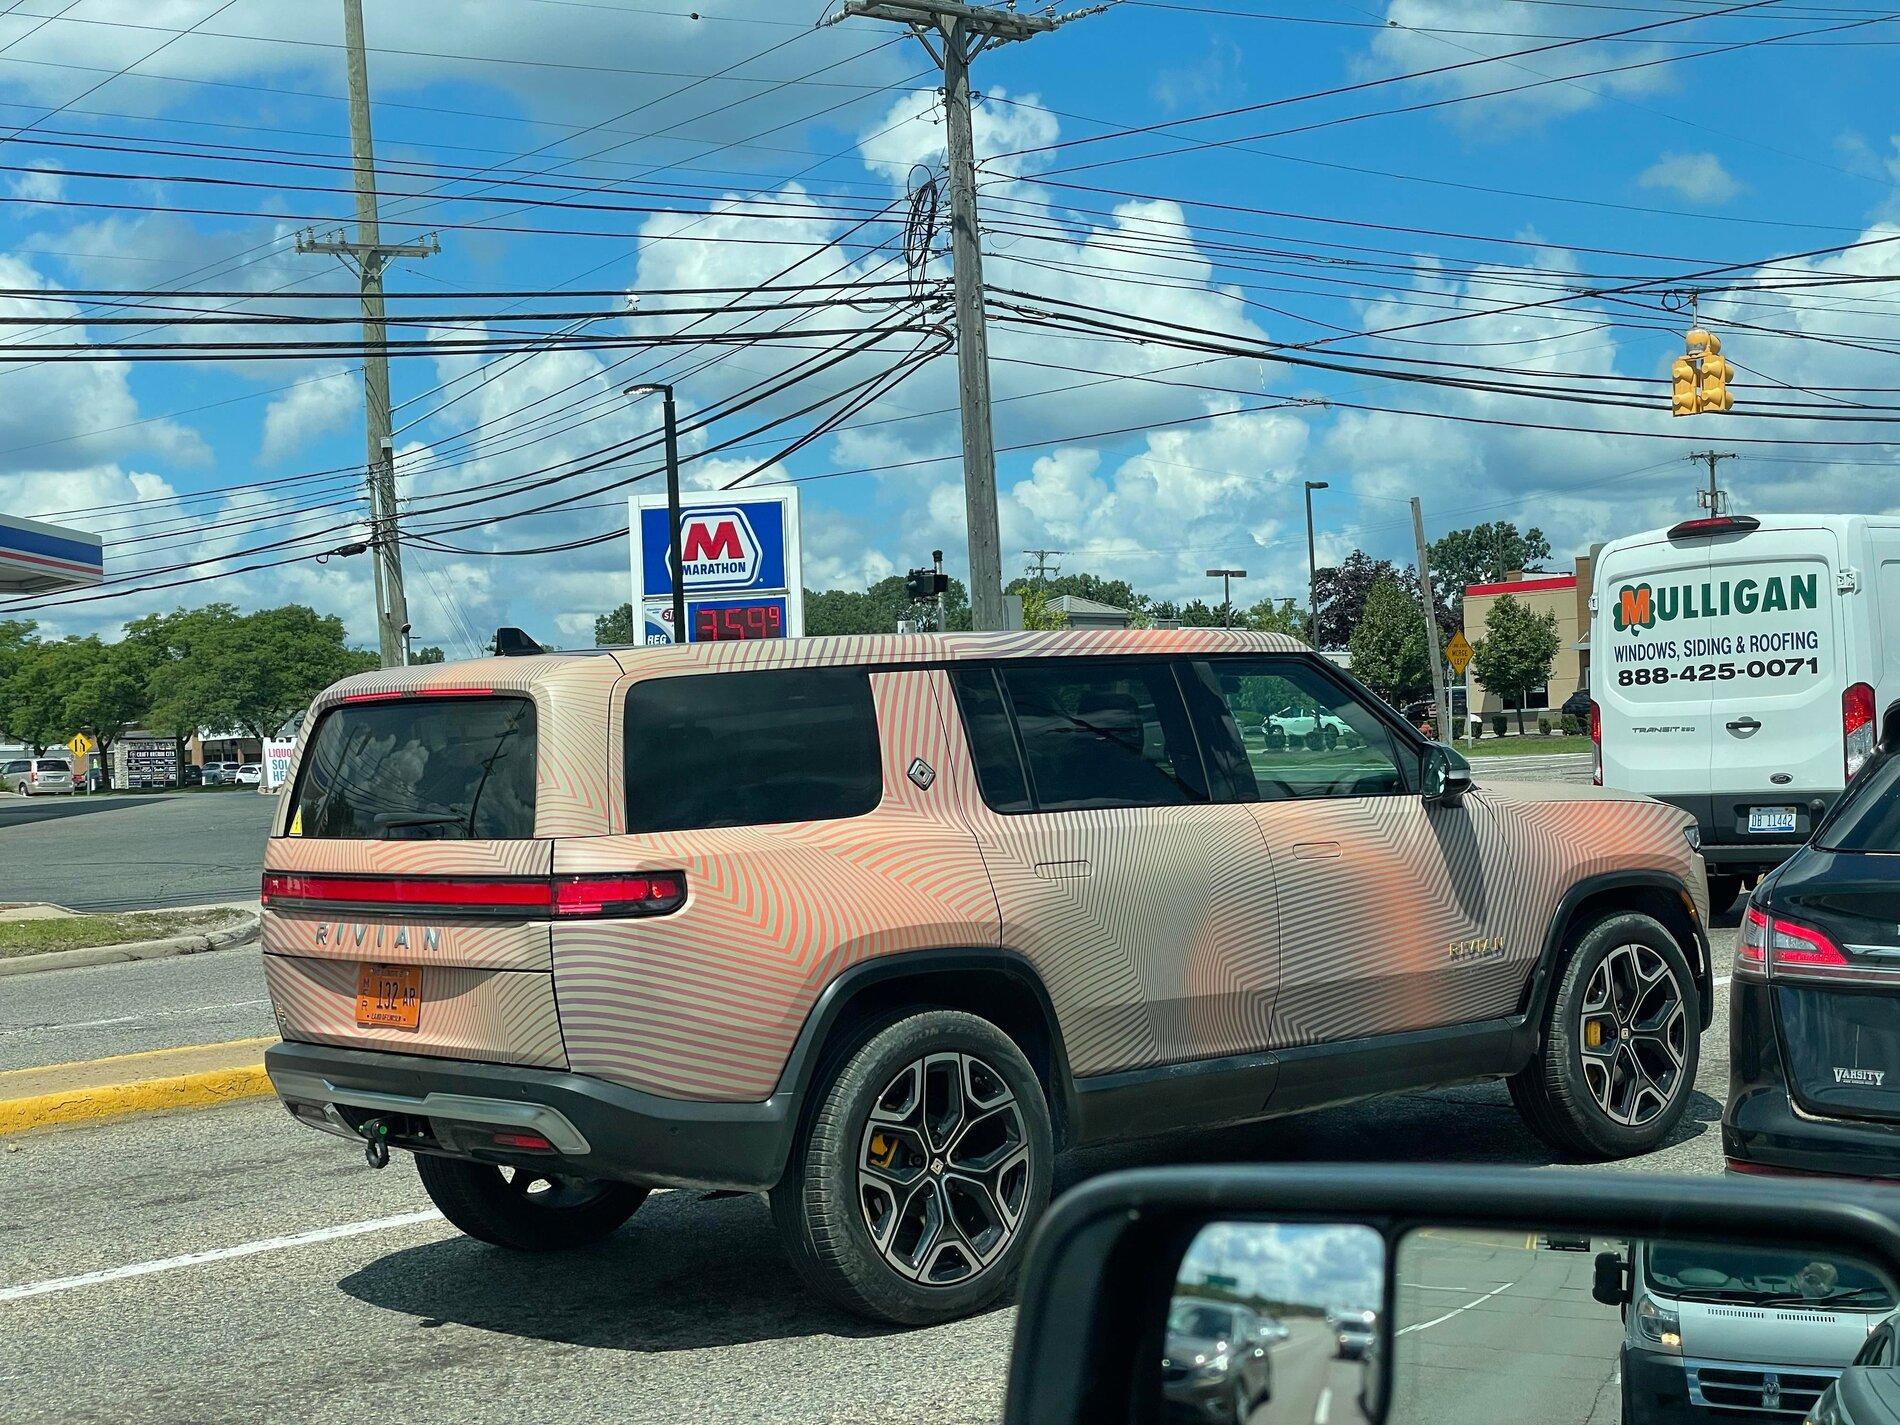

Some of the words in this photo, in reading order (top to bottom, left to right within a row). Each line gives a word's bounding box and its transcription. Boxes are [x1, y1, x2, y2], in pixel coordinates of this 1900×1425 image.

[682, 561, 746, 576] MARATHON
[1621, 573, 1818, 626] MULLIGAN
[1614, 640, 1680, 663] WINDOWS,
[1683, 636, 1732, 658] SIDING
[1735, 635, 1746, 654] &
[1749, 630, 1819, 652] ROOFING
[1617, 656, 1819, 687] 888-425-0071
[268, 748, 292, 758] LIQUO
[316, 922, 442, 951] RIVIAN
[376, 981, 399, 1010] 132
[402, 987, 416, 1008] AR
[1833, 1067, 1885, 1086] VARSITY
